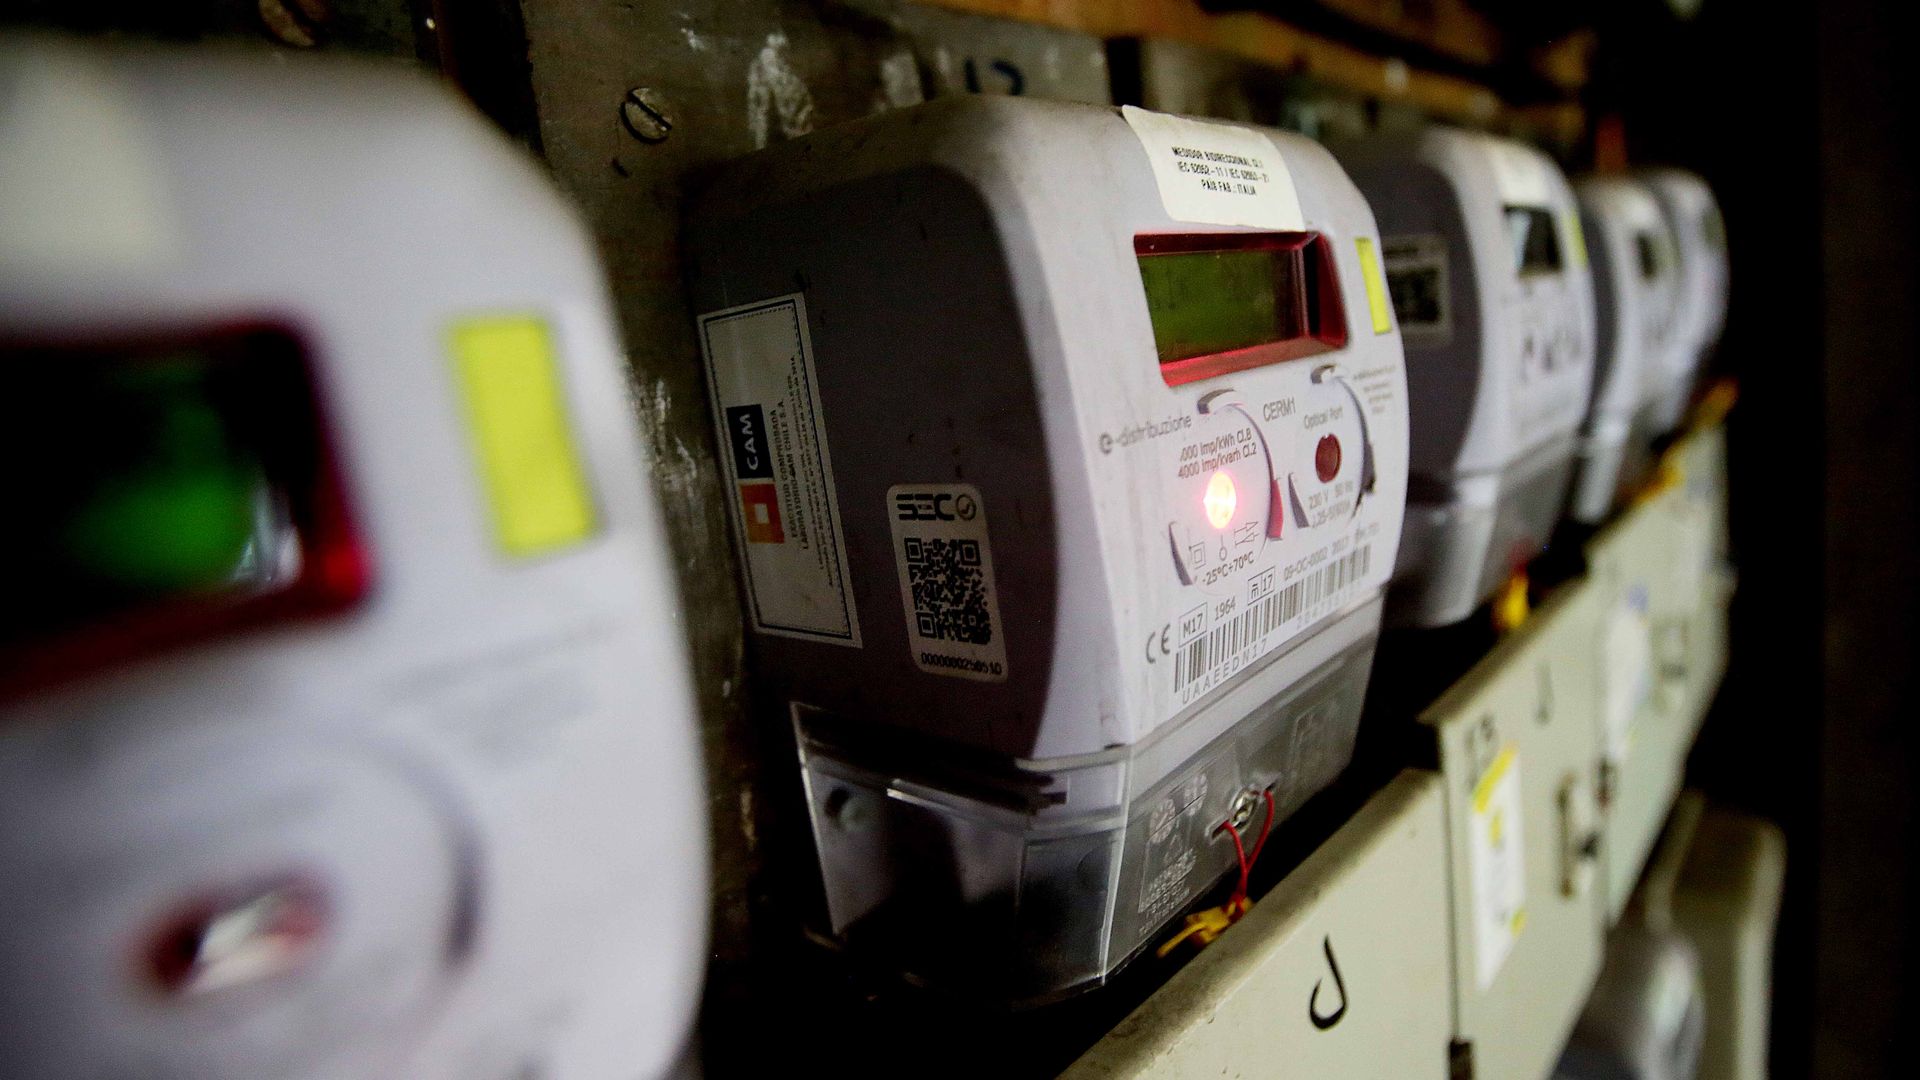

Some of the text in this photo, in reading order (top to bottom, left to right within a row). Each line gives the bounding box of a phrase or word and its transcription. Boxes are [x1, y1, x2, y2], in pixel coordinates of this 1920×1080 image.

[1171, 147, 1203, 160] MEDIDOR
[1177, 161, 1190, 173] IEC
[1263, 397, 1296, 422] CERM1
[1304, 406, 1344, 429] Optical Port
[739, 413, 759, 471] CAM
[780, 421, 792, 450] CHILE
[770, 408, 798, 537] EXACTITUD COMPROBADA
[1178, 460, 1201, 479] 4000
[791, 477, 809, 549] LABORATORIO
[895, 494, 955, 521] SEC
[1262, 574, 1274, 592] 17
[1215, 596, 1236, 621] 1964
[1183, 613, 1204, 639] M17
